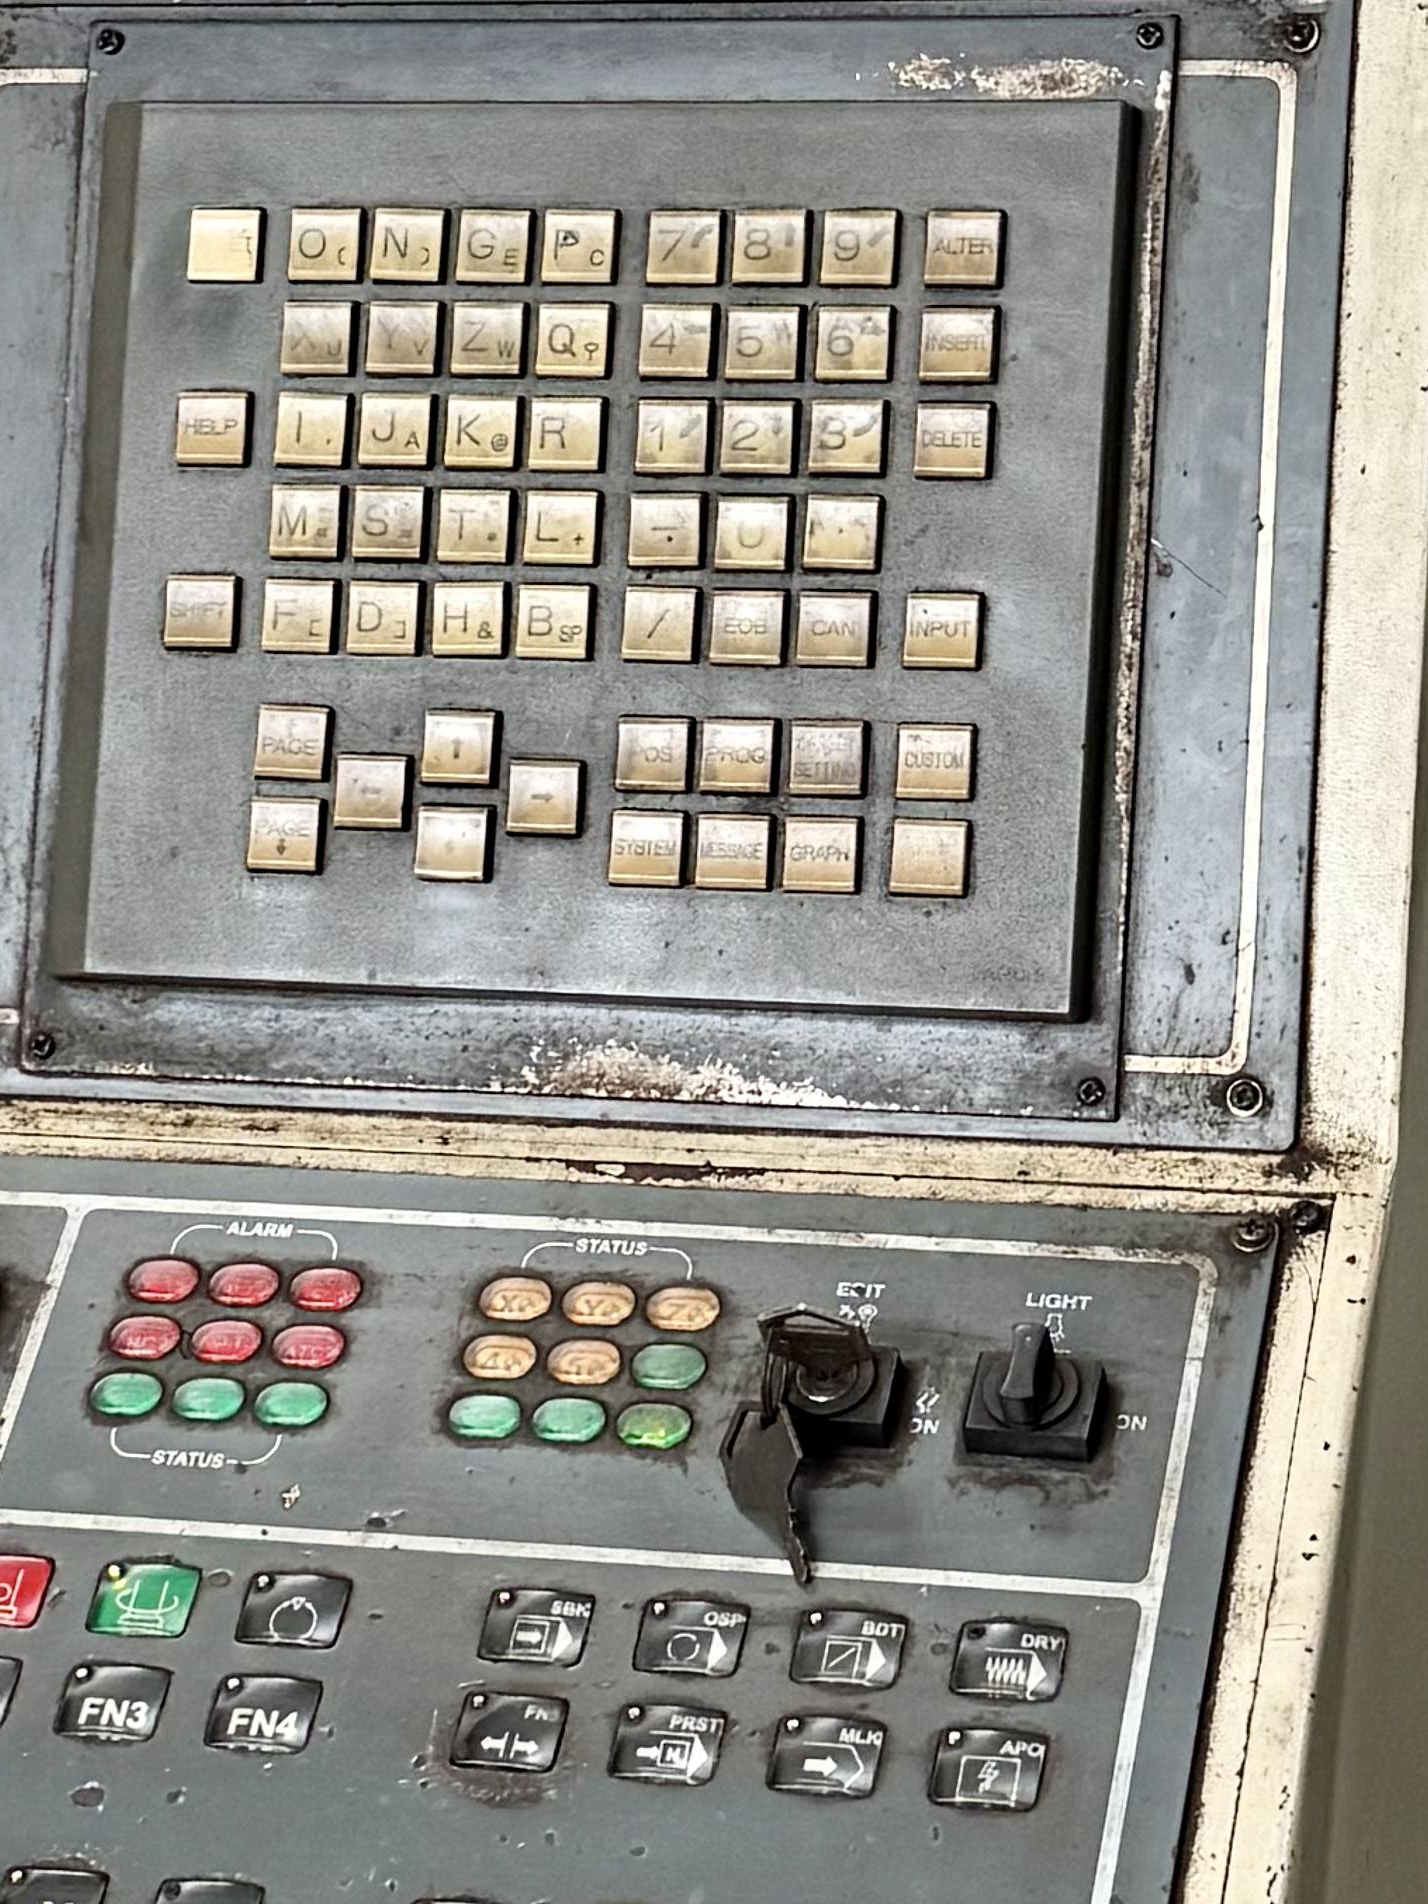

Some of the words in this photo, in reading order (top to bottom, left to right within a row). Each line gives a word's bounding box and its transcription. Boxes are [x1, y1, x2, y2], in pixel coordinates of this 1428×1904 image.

[382, 226, 409, 259] N
[467, 227, 498, 260] G
[553, 229, 580, 260] P
[659, 228, 686, 263] 7
[743, 227, 772, 261] 8
[833, 228, 861, 262] 9
[933, 236, 994, 256] ALTER
[547, 322, 577, 358] Q
[648, 322, 677, 355] 4
[736, 325, 764, 358] 5
[827, 324, 855, 358] 6
[183, 417, 239, 436] HELP
[372, 411, 395, 444] J
[455, 414, 482, 447] K
[539, 416, 566, 450] R
[730, 418, 760, 452] 2
[921, 429, 982, 449] DELETE
[276, 505, 307, 538] M
[361, 504, 389, 537] S
[536, 510, 560, 542] L
[357, 601, 383, 632] D
[442, 602, 469, 634] H
[527, 604, 554, 636] B
[723, 618, 768, 636] EOB
[811, 619, 858, 637] CAN
[909, 620, 971, 638] INPUT
[262, 737, 319, 756] PAGE
[904, 751, 964, 769] CUSTOM
[255, 818, 310, 837] PAGE
[790, 844, 850, 862] GRAPH
[226, 1220, 293, 1239] ALARM
[574, 1237, 649, 1257] STATUS
[1025, 1291, 1092, 1311] LIGHT
[151, 1449, 225, 1470] STATUS
[1020, 1633, 1061, 1651] DRY
[77, 1697, 149, 1728] FN3
[226, 1708, 299, 1737] FN4
[669, 1714, 721, 1733] PRST
